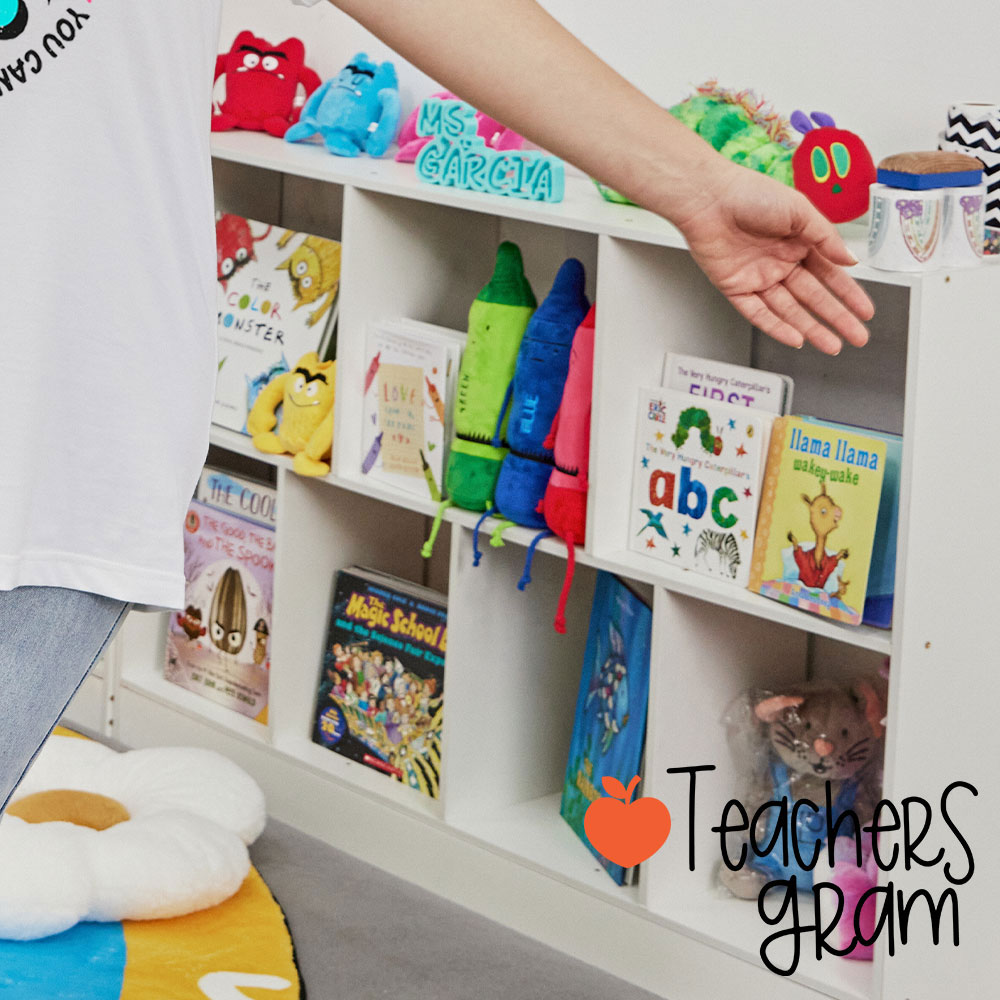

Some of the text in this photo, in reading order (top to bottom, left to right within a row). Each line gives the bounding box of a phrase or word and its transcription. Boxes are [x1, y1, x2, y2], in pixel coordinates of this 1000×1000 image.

[42, 7, 90, 59] YOU
[419, 143, 553, 199] GARCIA
[251, 278, 272, 292] THE
[227, 291, 282, 320] COLOR
[678, 366, 688, 376] The
[690, 369, 704, 380] Very
[705, 374, 728, 386] Hungry
[646, 442, 657, 453] The
[660, 447, 675, 460] Very
[678, 453, 702, 468] Hungry
[789, 427, 879, 470] llama llama
[793, 457, 859, 486] wakey-wake
[211, 477, 276, 522] THE COOL
[648, 466, 739, 529] abc
[216, 536, 235, 557] THE
[346, 592, 390, 628] Magic
[390, 608, 441, 646] School
